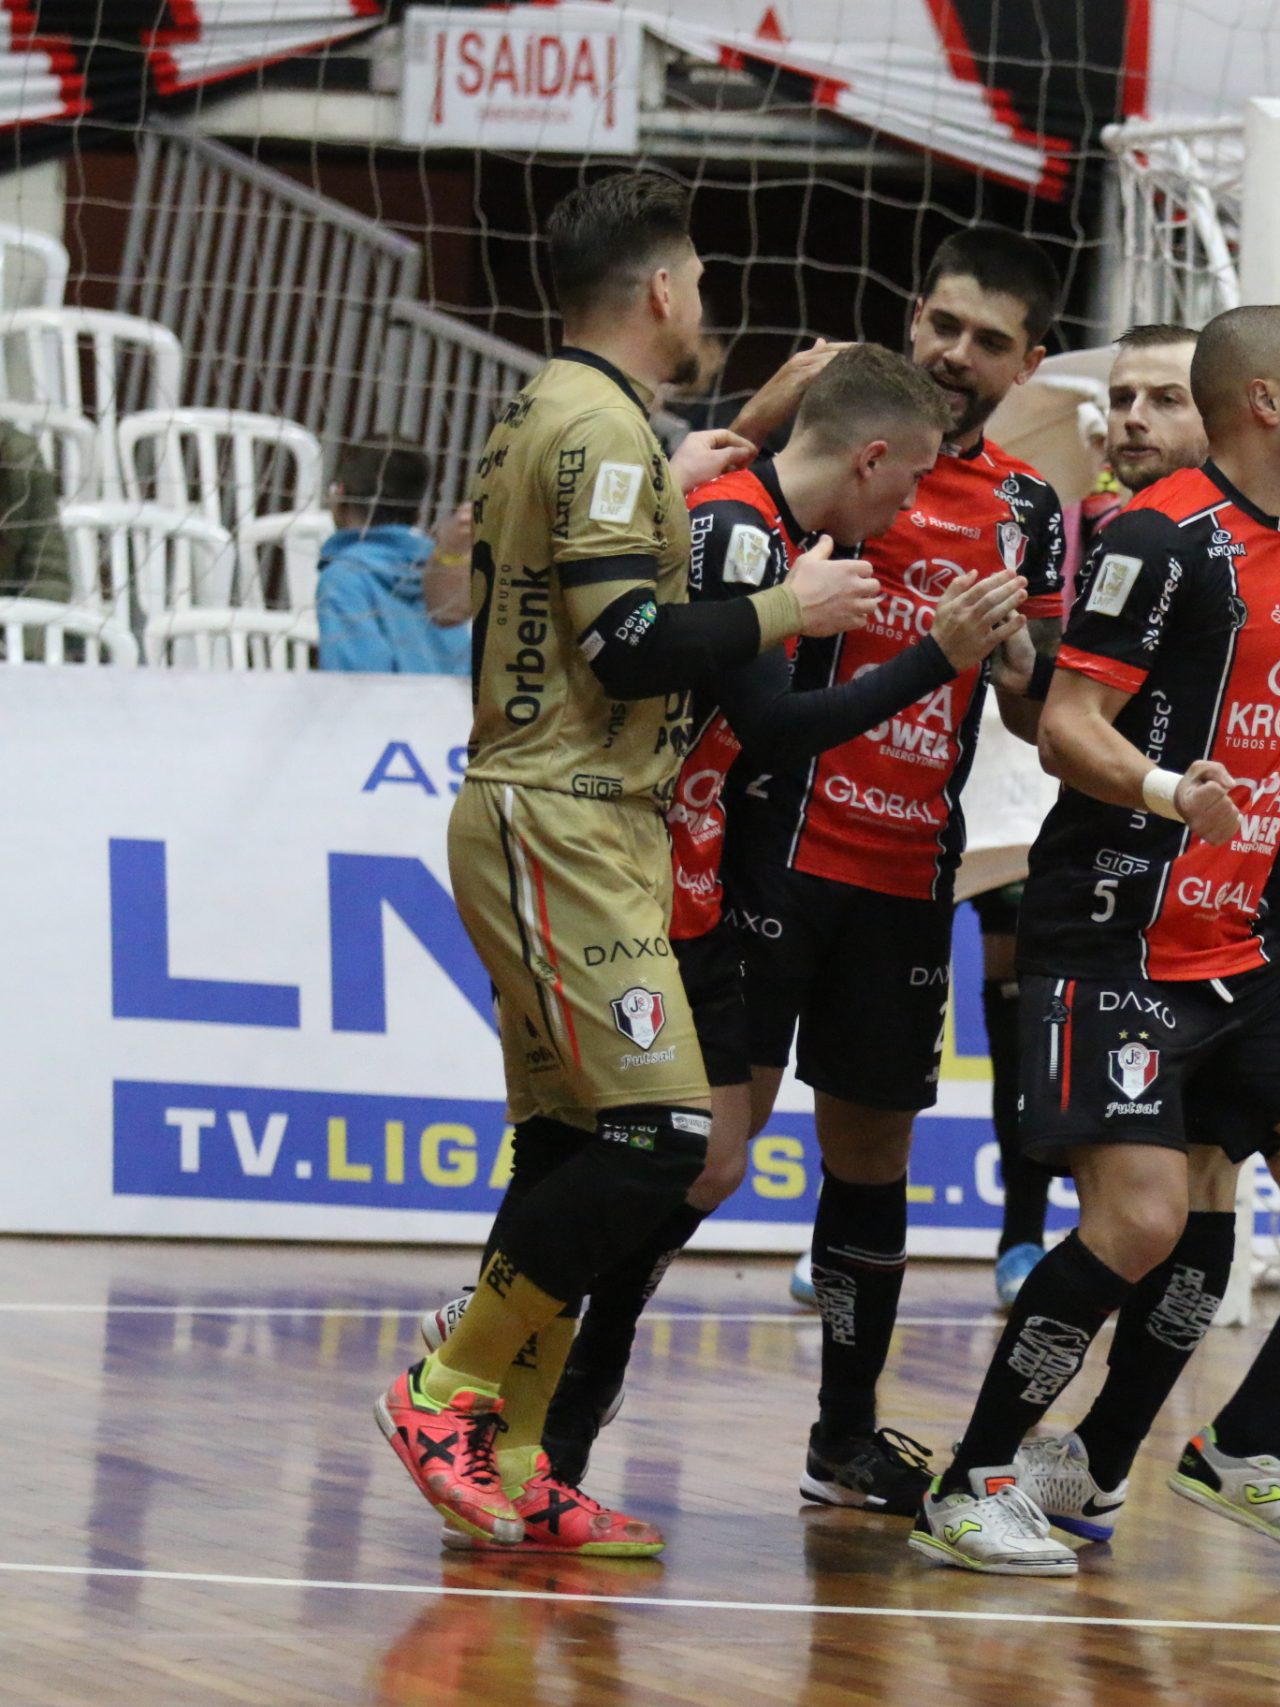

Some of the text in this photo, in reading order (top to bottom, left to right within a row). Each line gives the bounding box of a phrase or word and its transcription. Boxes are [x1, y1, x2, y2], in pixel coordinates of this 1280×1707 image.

[552, 446, 586, 540] Ebury
[928, 515, 982, 541] RHBrasil
[687, 512, 724, 591] Ebury
[1207, 543, 1247, 559] KRONA
[496, 562, 513, 627] GRUPO
[1148, 556, 1184, 628] Sicredi
[504, 564, 551, 727] Orbenk
[1225, 736, 1266, 751] TUBOS
[824, 774, 941, 826] GLOBAL
[1090, 878, 1119, 923] 5
[723, 908, 784, 939] AXO
[582, 936, 670, 968] DAXO
[1099, 990, 1177, 1030] DAXO
[620, 1045, 677, 1070] Futsal
[1104, 1099, 1163, 1118] Futsal
[602, 1129, 630, 1144] #92
